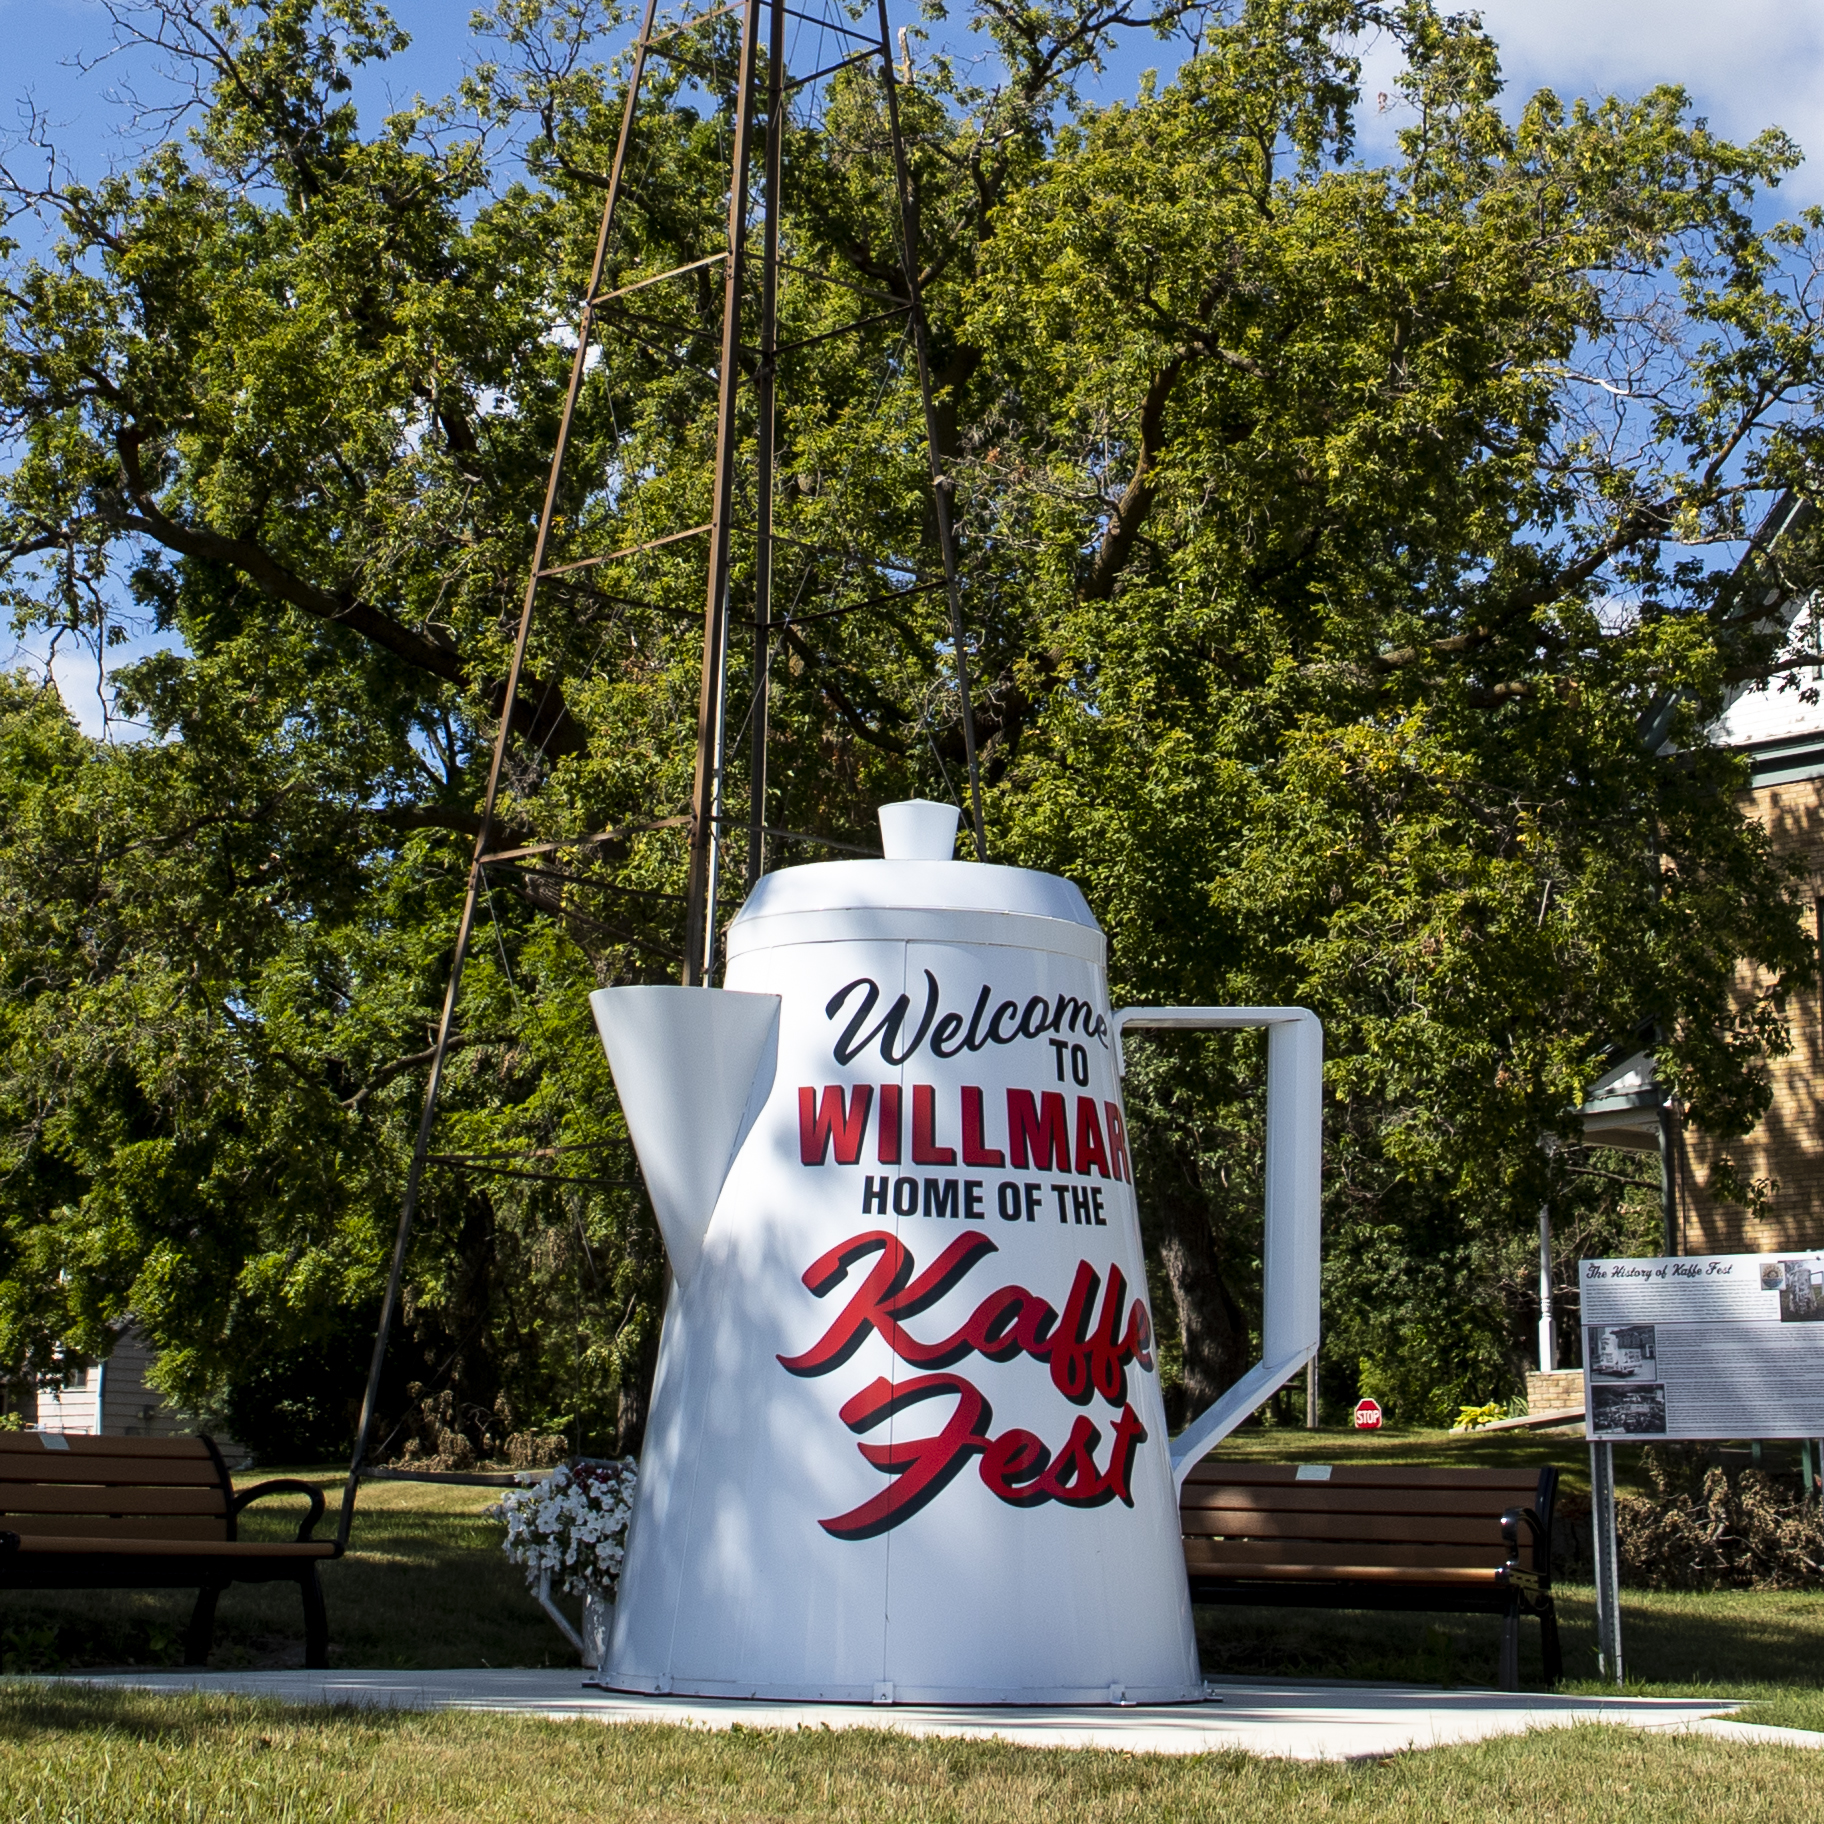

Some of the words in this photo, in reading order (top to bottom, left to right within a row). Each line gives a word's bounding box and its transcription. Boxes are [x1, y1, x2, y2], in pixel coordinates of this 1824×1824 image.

[825, 967, 1109, 1066] Welcome
[1048, 1037, 1090, 1088] TO
[798, 1083, 1132, 1185] WILLMAR
[862, 1175, 985, 1220] HOME
[997, 1180, 1043, 1223] OF
[1050, 1183, 1108, 1227] THE
[1586, 1264, 1607, 1279] The
[1611, 1265, 1653, 1282] History
[1655, 1264, 1668, 1279] of
[1672, 1262, 1703, 1279] Kaffe
[1705, 1261, 1734, 1276] Fest
[776, 1229, 1155, 1409] Kaffe
[1356, 1410, 1380, 1424] STOP
[817, 1372, 1148, 1542] Fest
